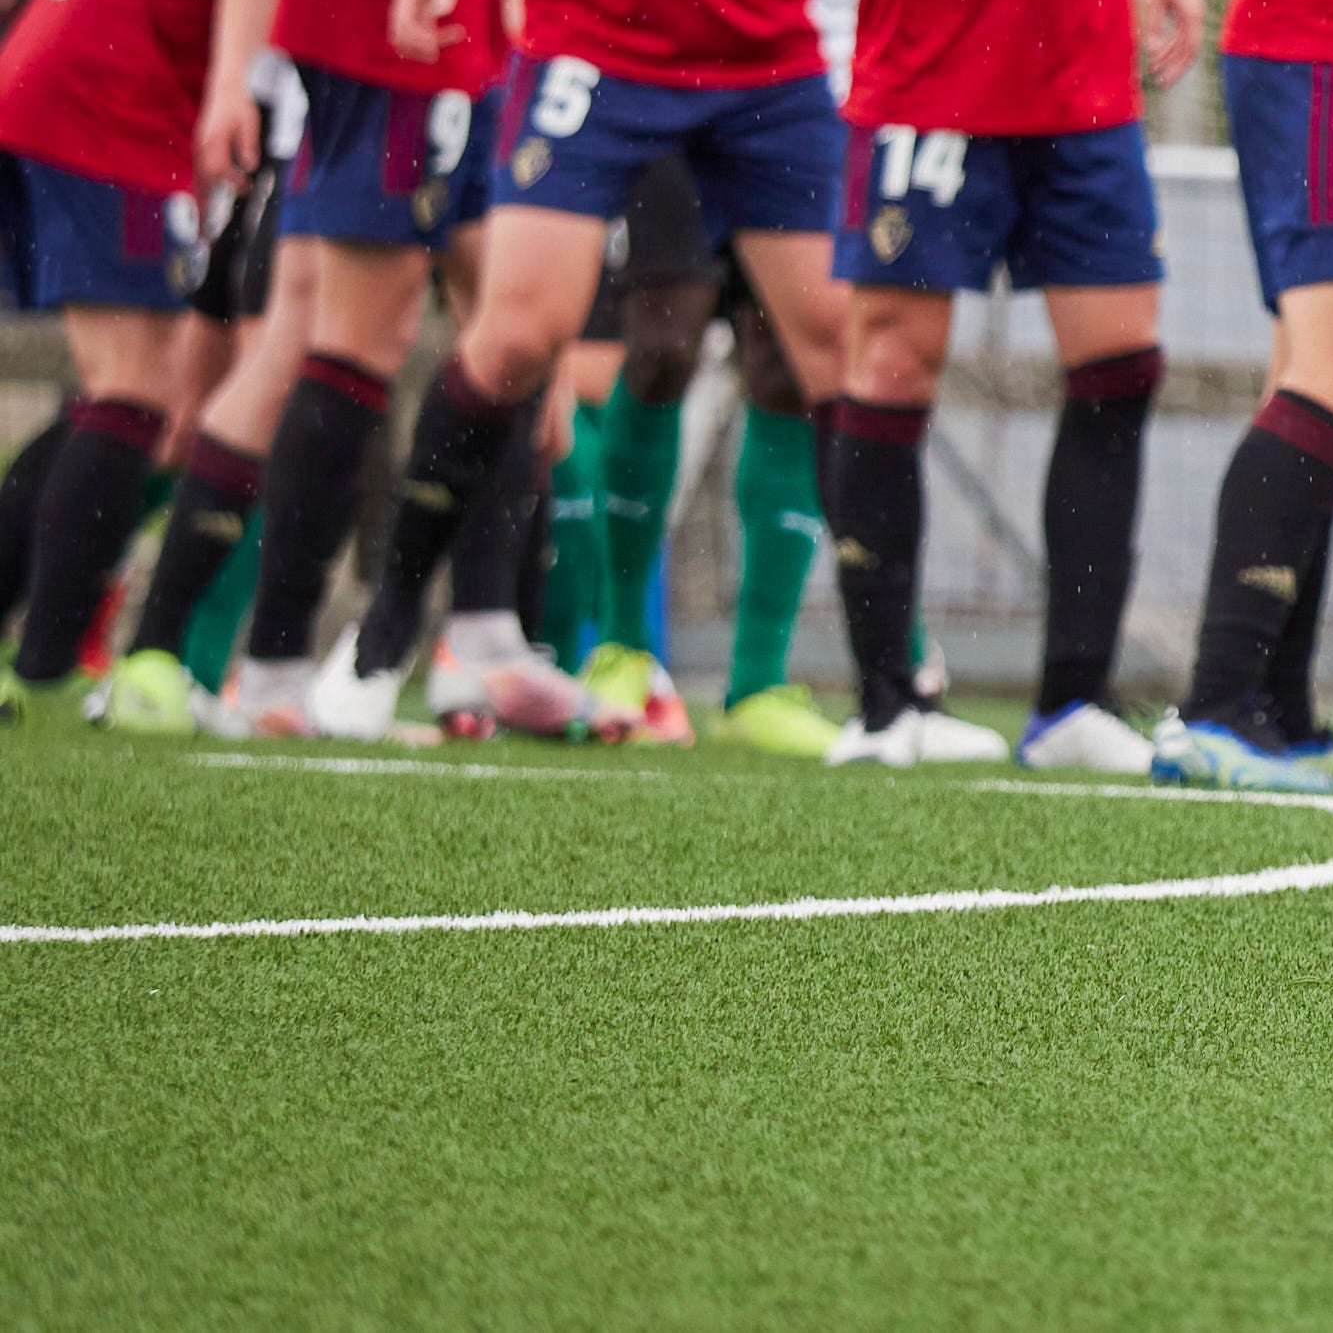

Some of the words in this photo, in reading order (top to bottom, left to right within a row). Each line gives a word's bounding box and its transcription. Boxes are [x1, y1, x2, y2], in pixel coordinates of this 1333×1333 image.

[430, 87, 472, 175] 9
[532, 54, 602, 139] 5
[876, 124, 969, 208] 14
